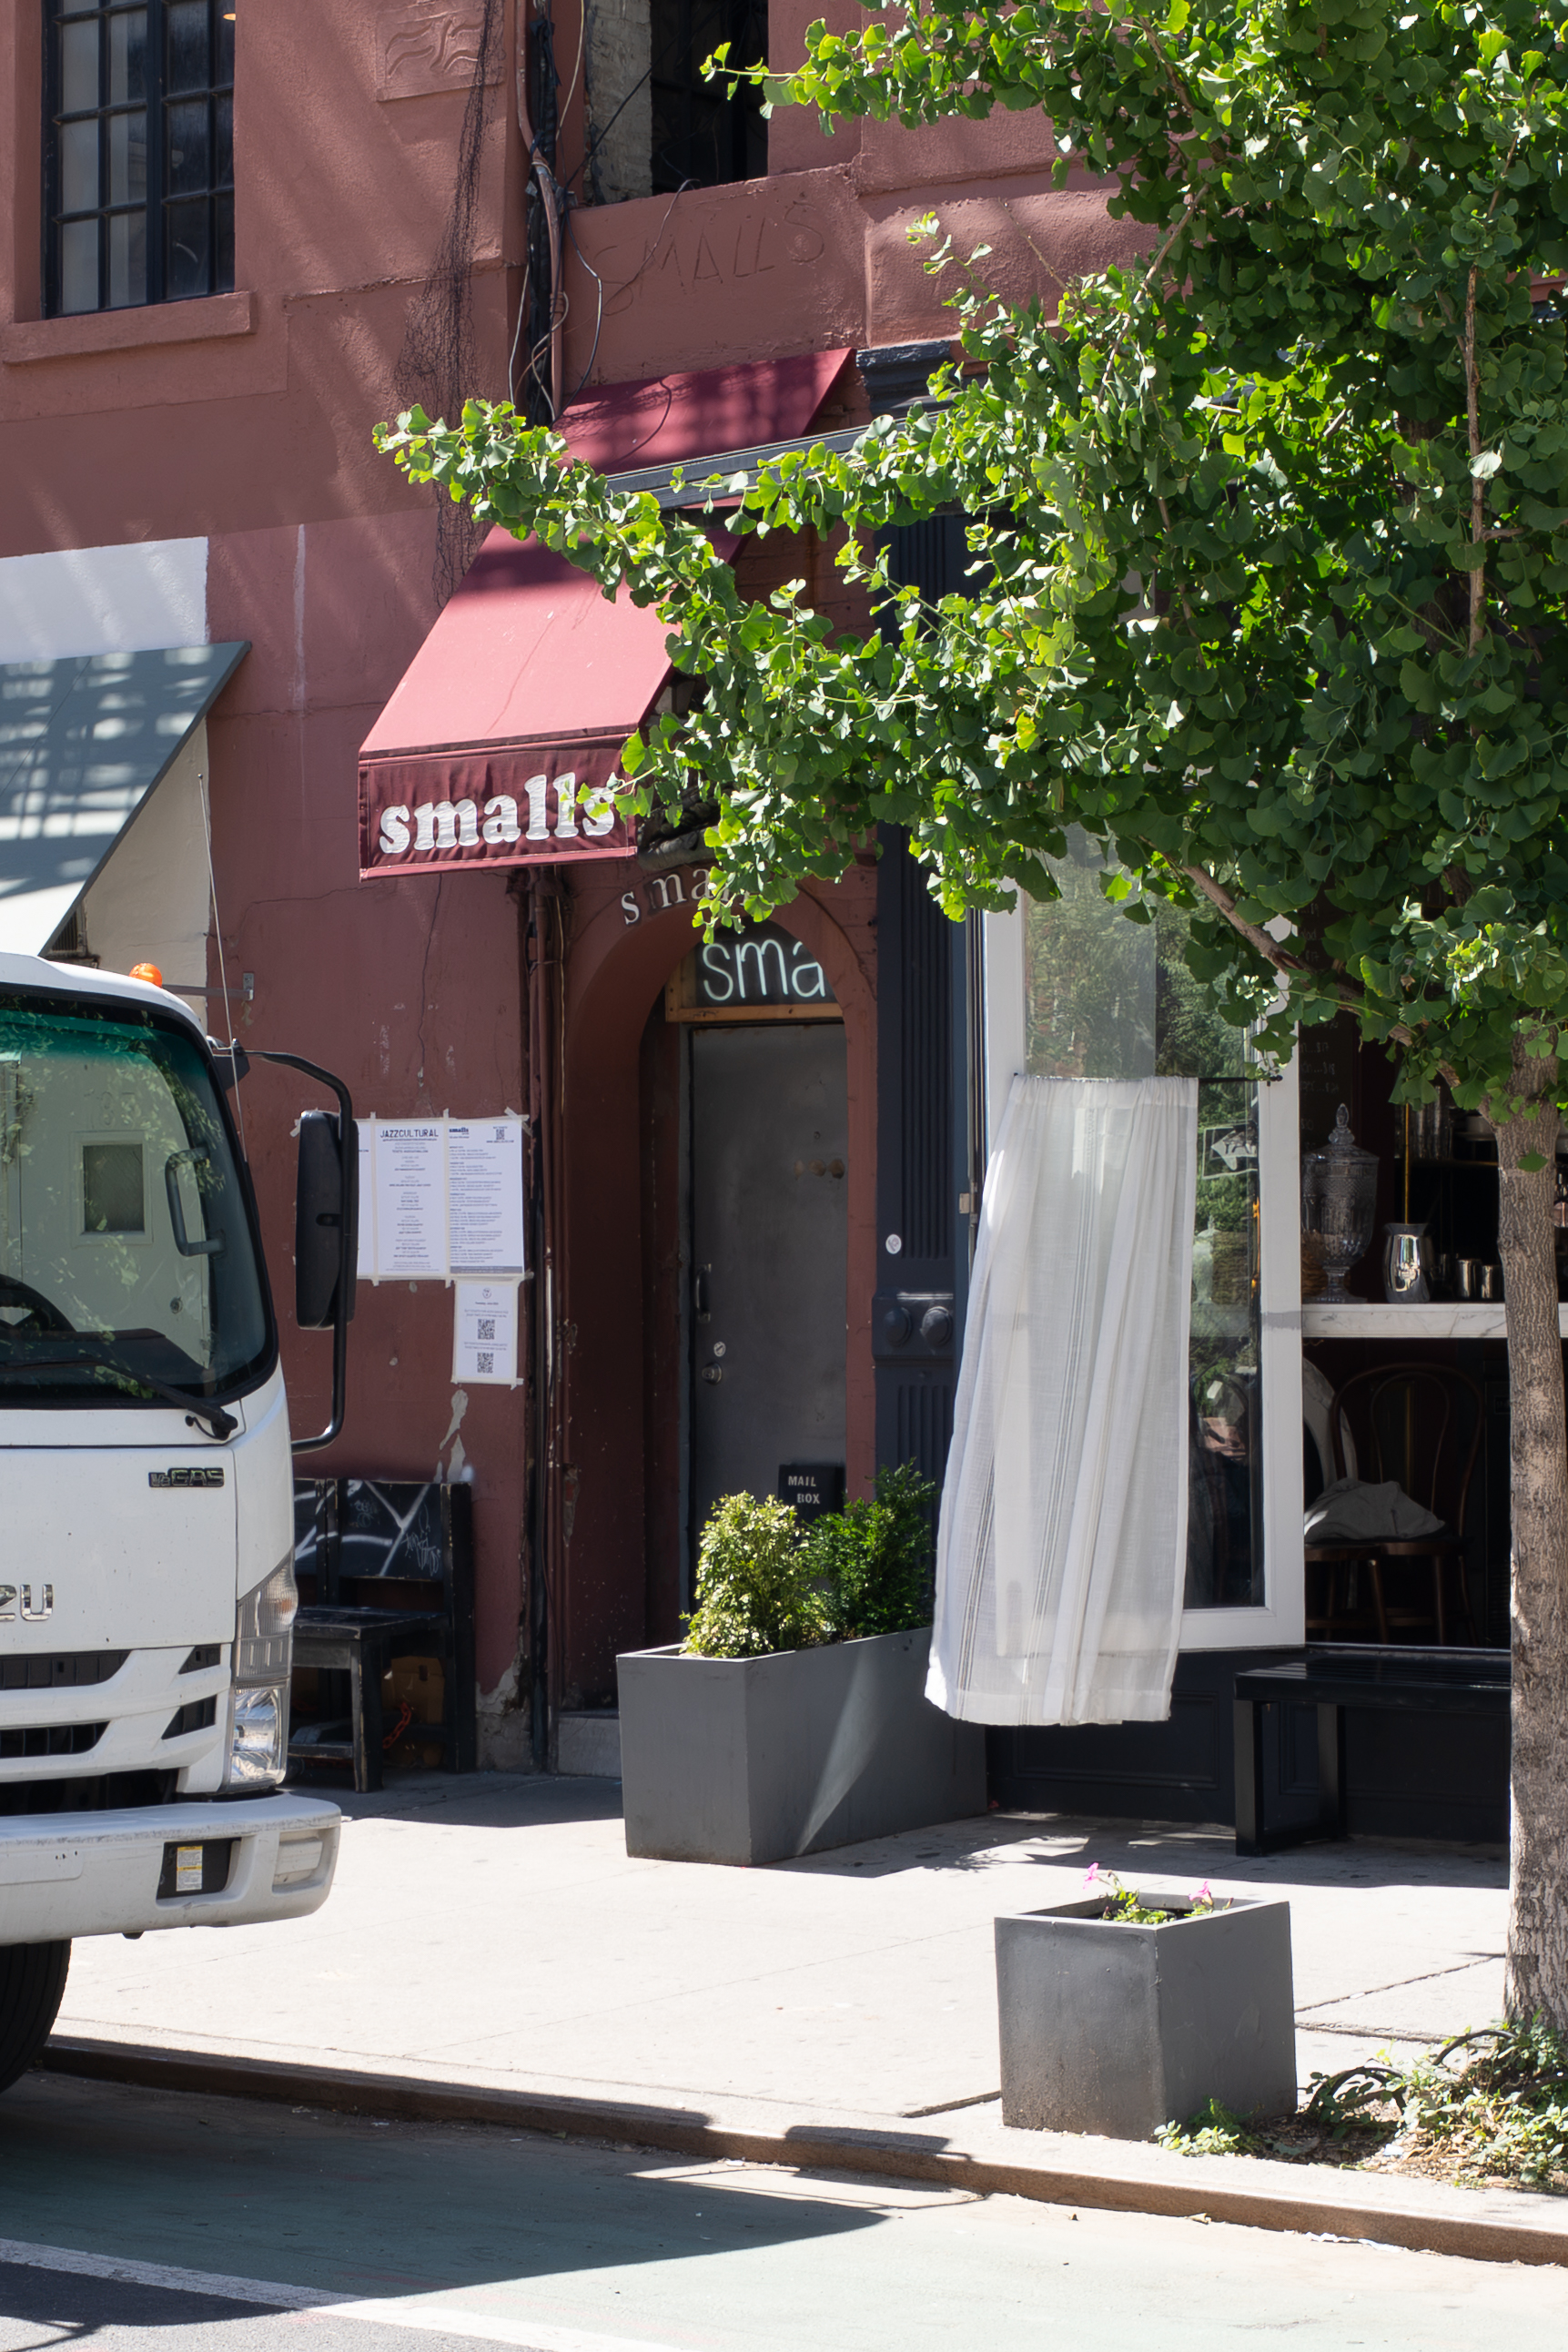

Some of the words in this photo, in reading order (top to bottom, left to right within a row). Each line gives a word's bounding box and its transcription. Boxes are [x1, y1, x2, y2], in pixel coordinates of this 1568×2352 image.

[379, 772, 615, 854] smalls
[379, 1129, 439, 1139] JAZZCULTURAL
[788, 1475, 816, 1486] MAIL
[797, 1493, 820, 1504] BOX
